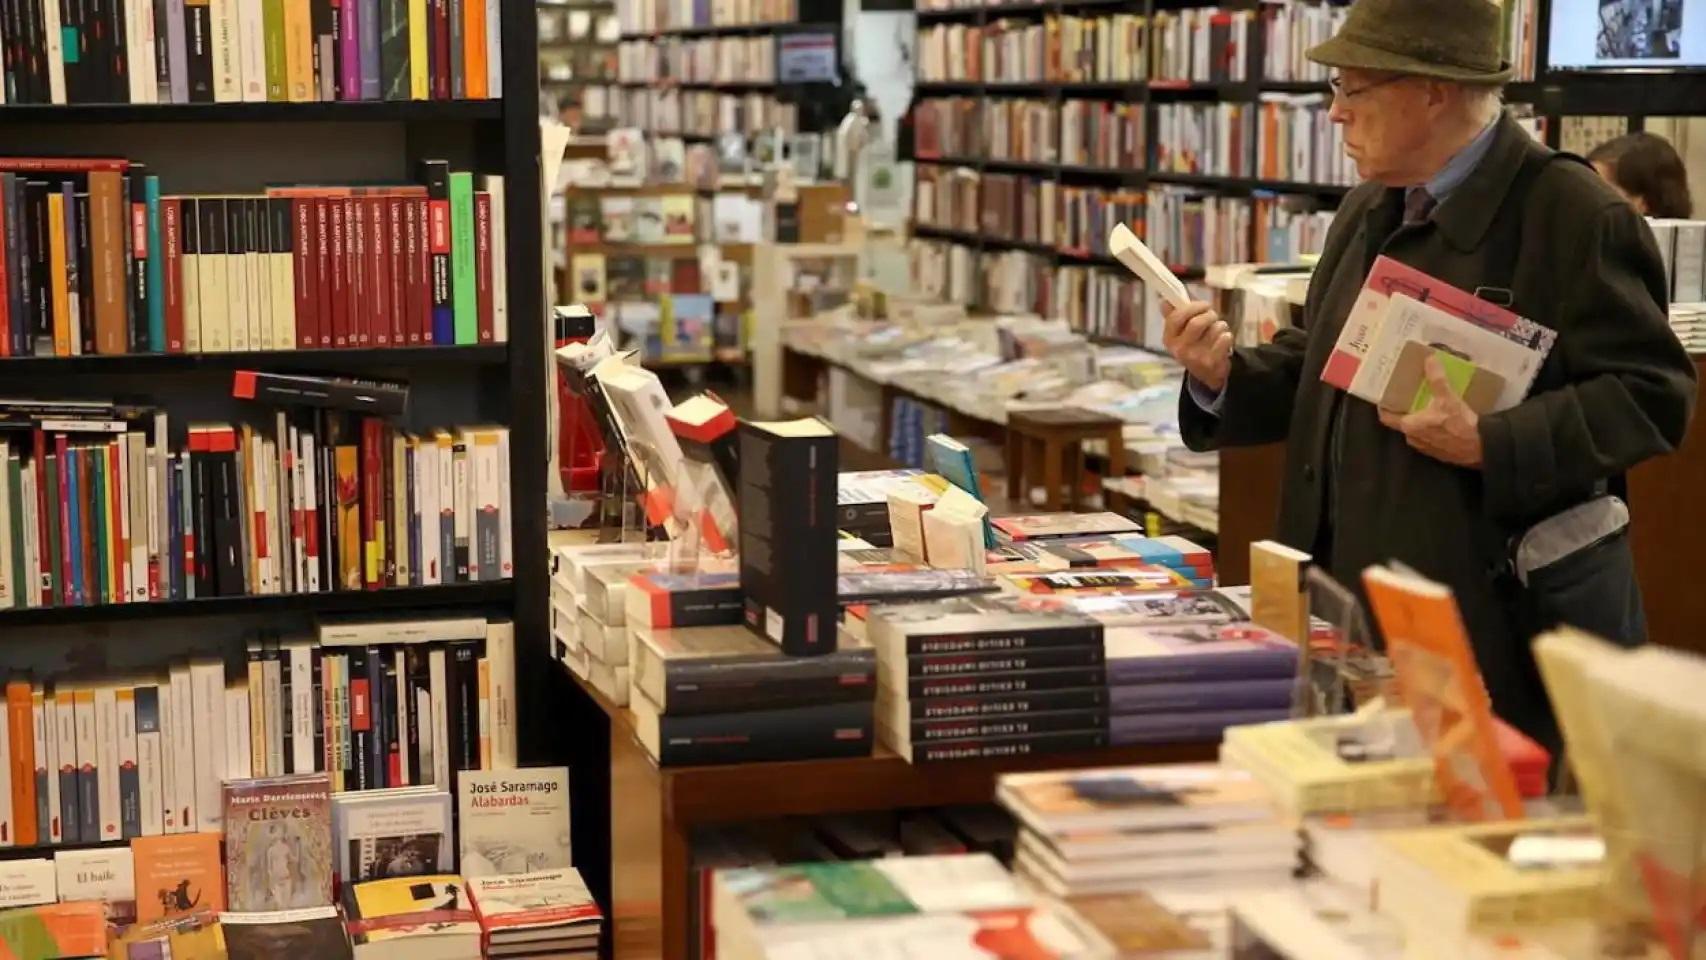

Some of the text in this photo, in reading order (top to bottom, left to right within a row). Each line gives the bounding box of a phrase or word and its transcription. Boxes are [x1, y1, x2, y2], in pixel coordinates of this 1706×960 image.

[470, 780, 558, 795] José Saramago
[471, 795, 529, 808] Alabardas
[249, 807, 311, 821] Clèves
